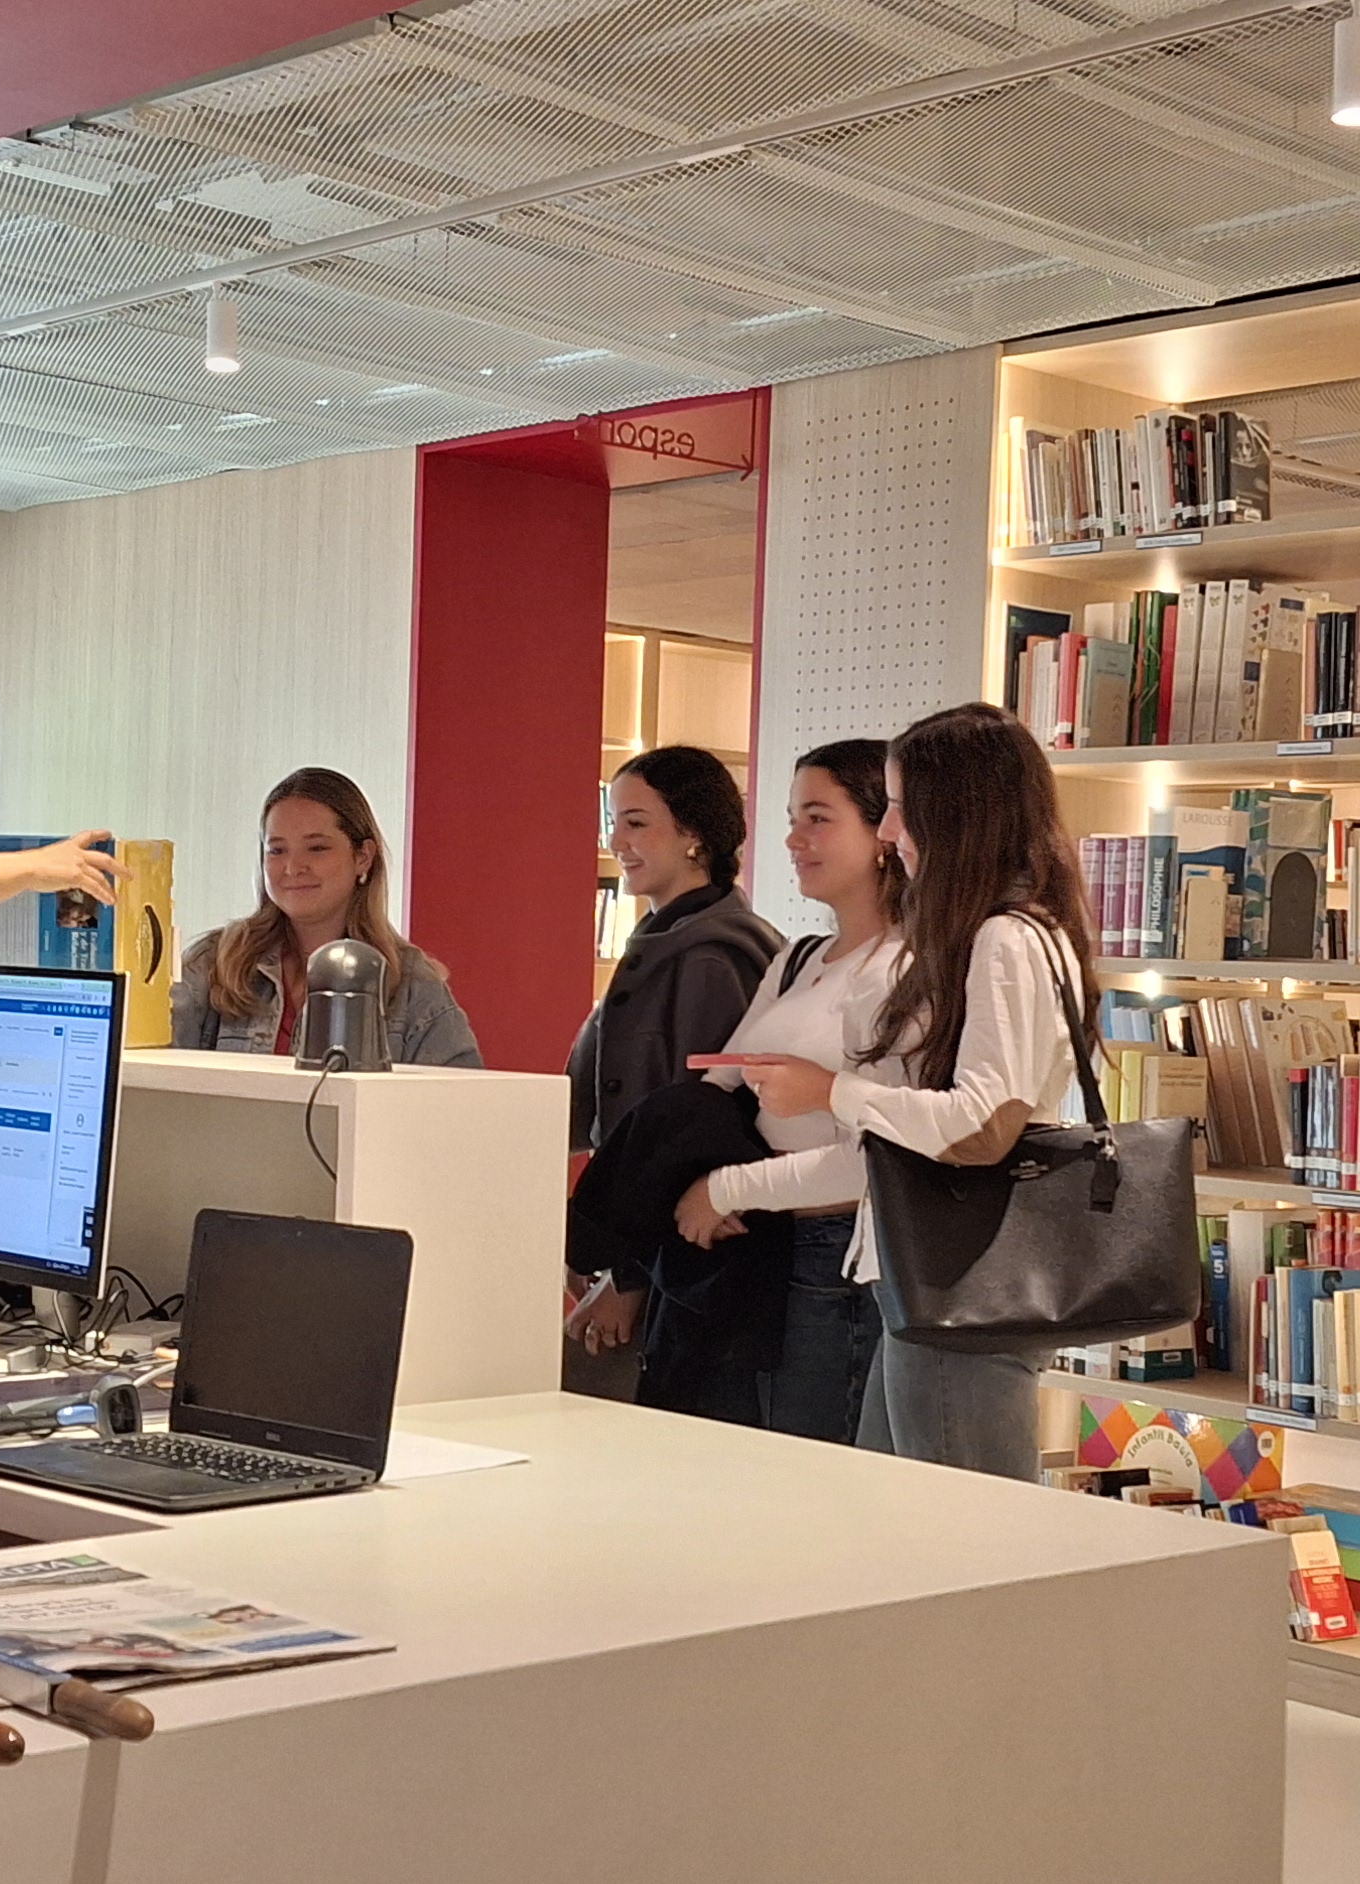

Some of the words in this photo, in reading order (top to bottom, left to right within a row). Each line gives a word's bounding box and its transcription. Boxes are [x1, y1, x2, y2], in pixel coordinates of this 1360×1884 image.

[1150, 857, 1165, 931] PHILOSOPHIE
[1213, 1258, 1225, 1275] 5
[1127, 1429, 1165, 1459] Infantil
[1166, 1432, 1194, 1468] Baula
